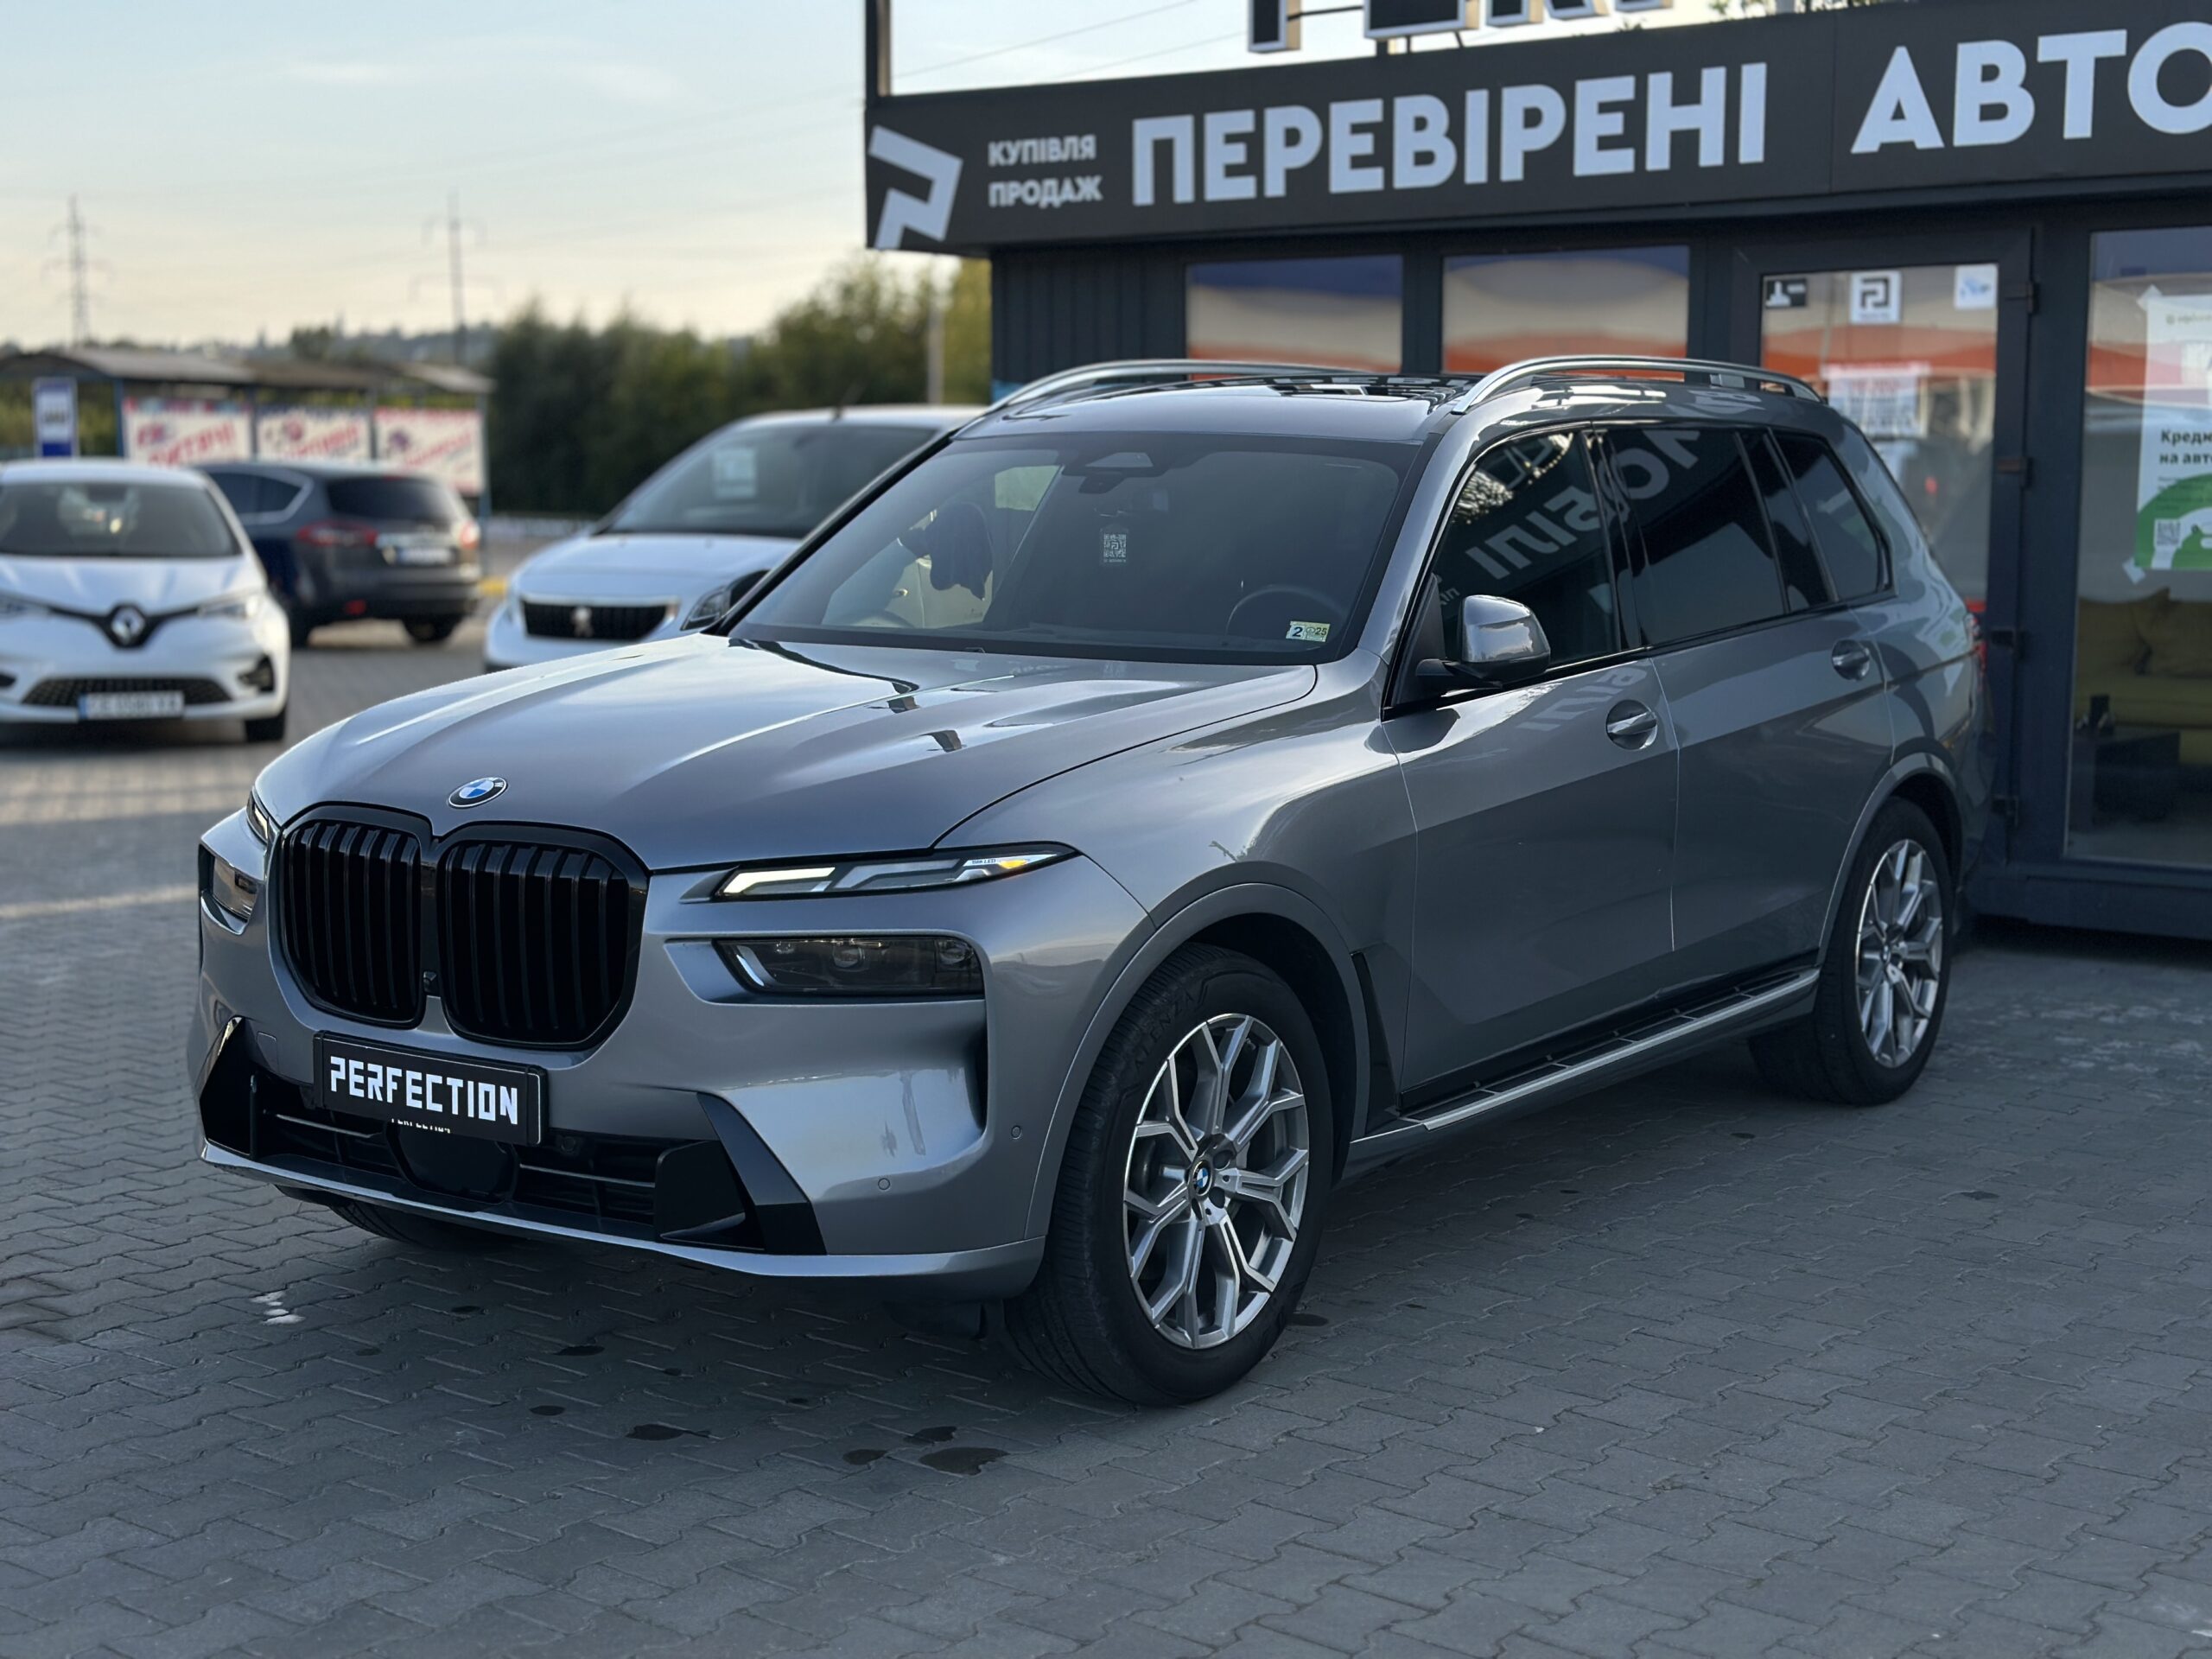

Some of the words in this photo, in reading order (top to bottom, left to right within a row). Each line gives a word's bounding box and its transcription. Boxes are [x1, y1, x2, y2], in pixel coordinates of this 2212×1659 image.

[1133, 62, 1768, 207] ПЕРЕВІРЕНІ
[1850, 21, 2212, 154] АВТО
[988, 134, 1096, 167] КУПІВЛЯ
[988, 175, 1103, 209] ПРОДАЖ
[2159, 454, 2178, 465] на
[2183, 454, 2212, 465] авт
[1292, 626, 1303, 638] 2
[330, 1056, 518, 1125] PERFECTION
